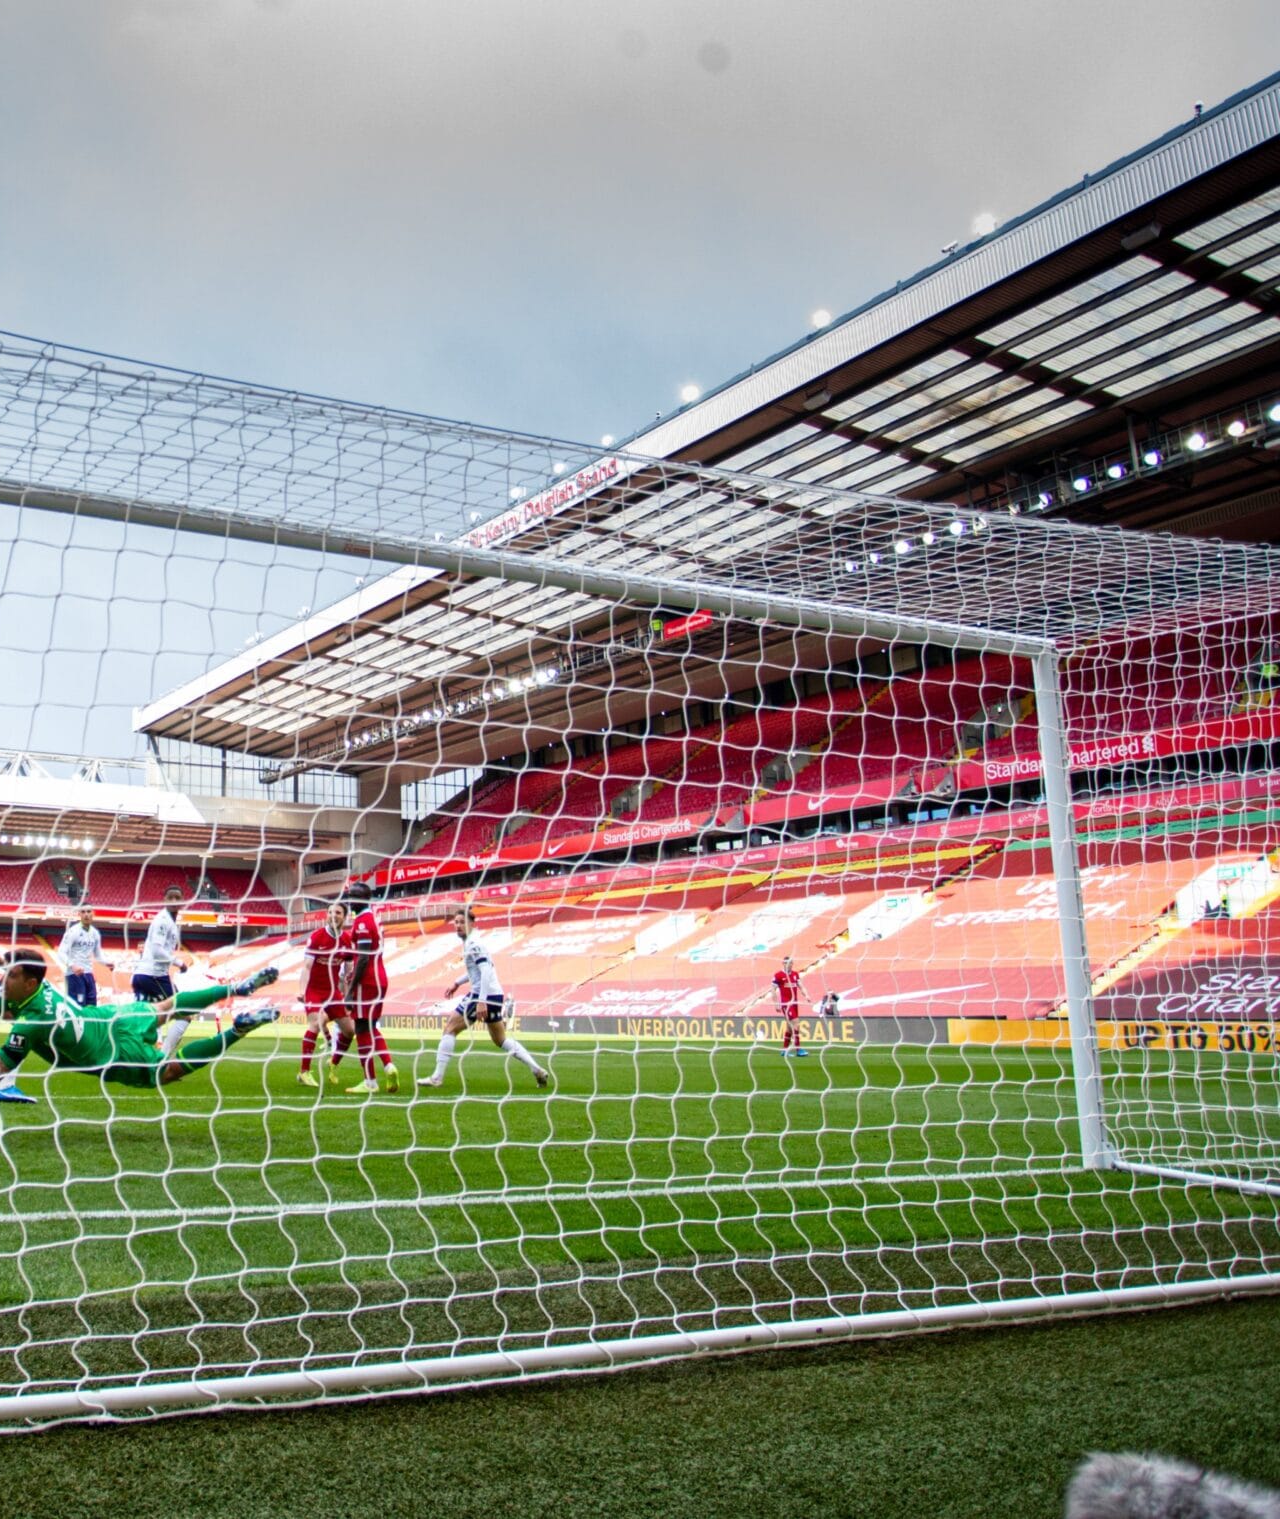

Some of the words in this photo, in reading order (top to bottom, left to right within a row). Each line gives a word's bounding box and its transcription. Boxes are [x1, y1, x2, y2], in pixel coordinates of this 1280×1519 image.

[524, 482, 574, 520] Dalglish
[986, 757, 1044, 780] Standar
[1067, 739, 1140, 766] hartered
[603, 828, 641, 846] Standard
[641, 821, 684, 839] Chartered
[1199, 972, 1280, 991] Sta
[9, 1033, 25, 1046] LT
[1123, 1024, 1161, 1049] UP
[1166, 1025, 1208, 1050] TO
